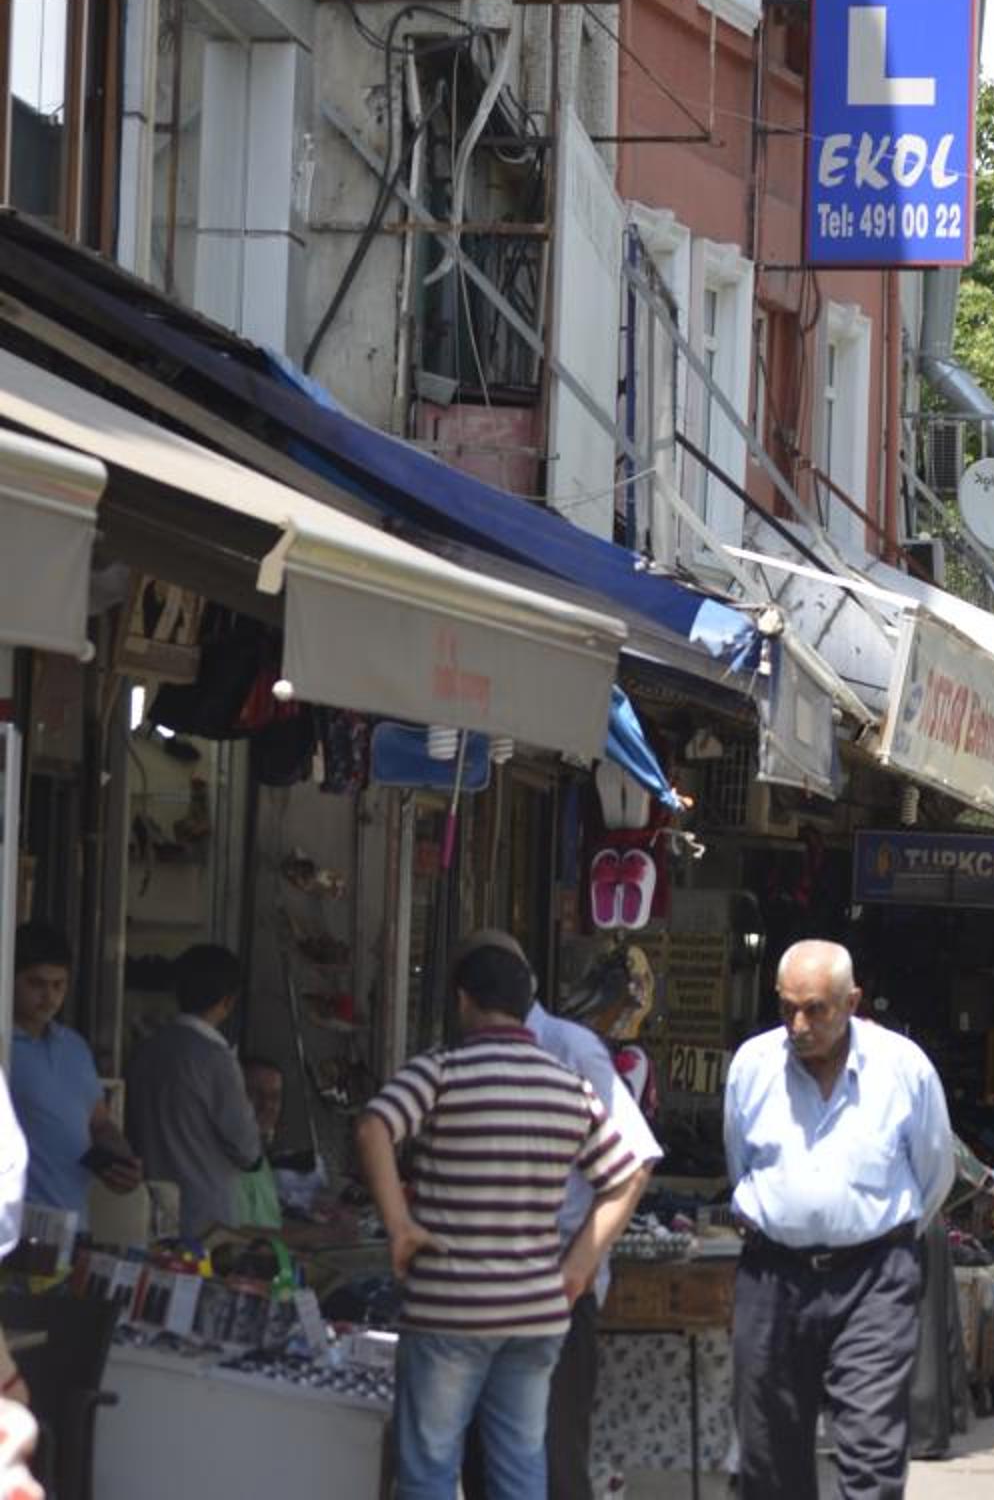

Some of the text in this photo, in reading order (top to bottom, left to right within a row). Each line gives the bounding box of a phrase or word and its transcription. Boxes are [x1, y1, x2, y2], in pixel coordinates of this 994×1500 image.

[818, 131, 960, 191] EKOL
[817, 203, 961, 238] Tel: 491 00 22
[673, 1048, 697, 1087] 20
